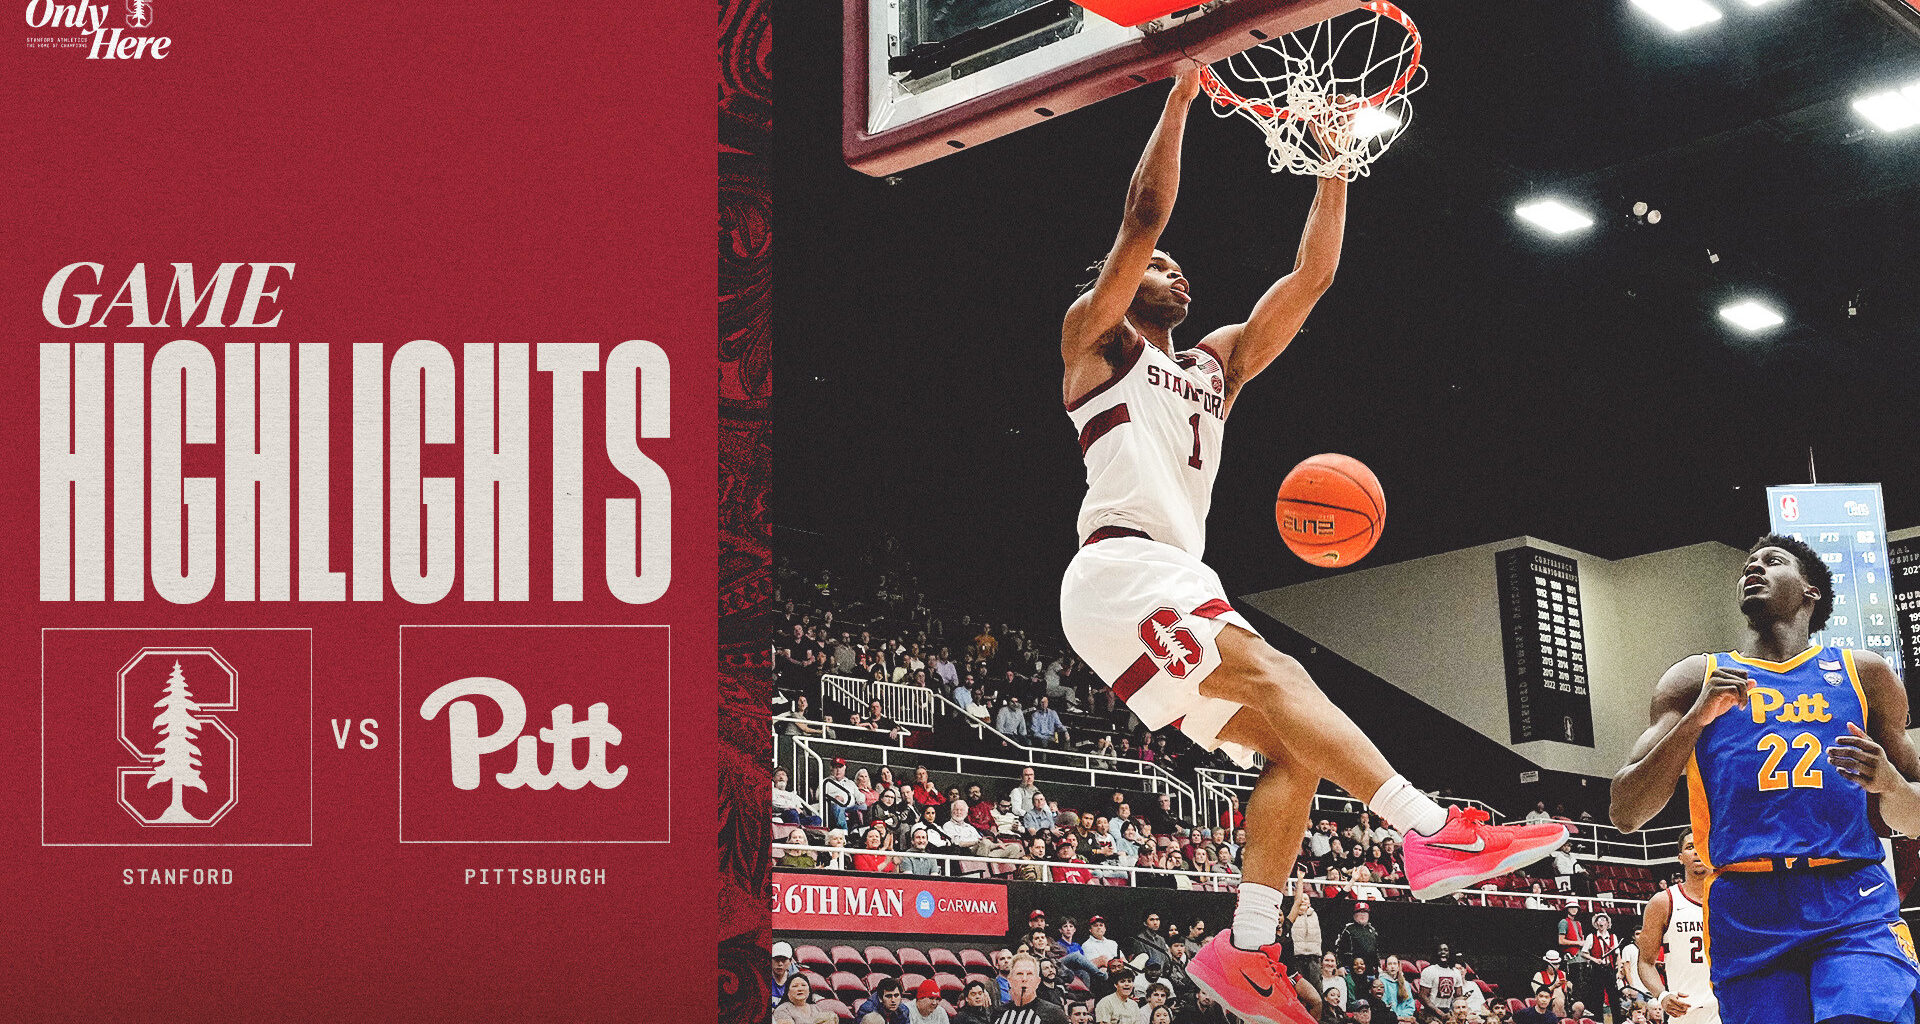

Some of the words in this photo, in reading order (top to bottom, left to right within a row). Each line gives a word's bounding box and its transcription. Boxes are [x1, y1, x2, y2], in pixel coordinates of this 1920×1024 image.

[1188, 413, 1202, 470] 1
[1819, 532, 1840, 542] PTS
[1861, 551, 1876, 564] 19
[1831, 573, 1846, 583] ST
[1866, 571, 1876, 584] 9
[1834, 594, 1847, 605] TL
[1869, 592, 1879, 605] 5
[1833, 615, 1848, 627] TO
[1870, 613, 1884, 626] 12
[1544, 679, 1556, 689] 2022
[1747, 687, 1833, 724] Pitt
[1757, 732, 1823, 791] 22
[784, 884, 840, 915] 6TH
[843, 886, 904, 917] MAN
[937, 898, 998, 914] CARVANA
[1676, 921, 1703, 933] STAN
